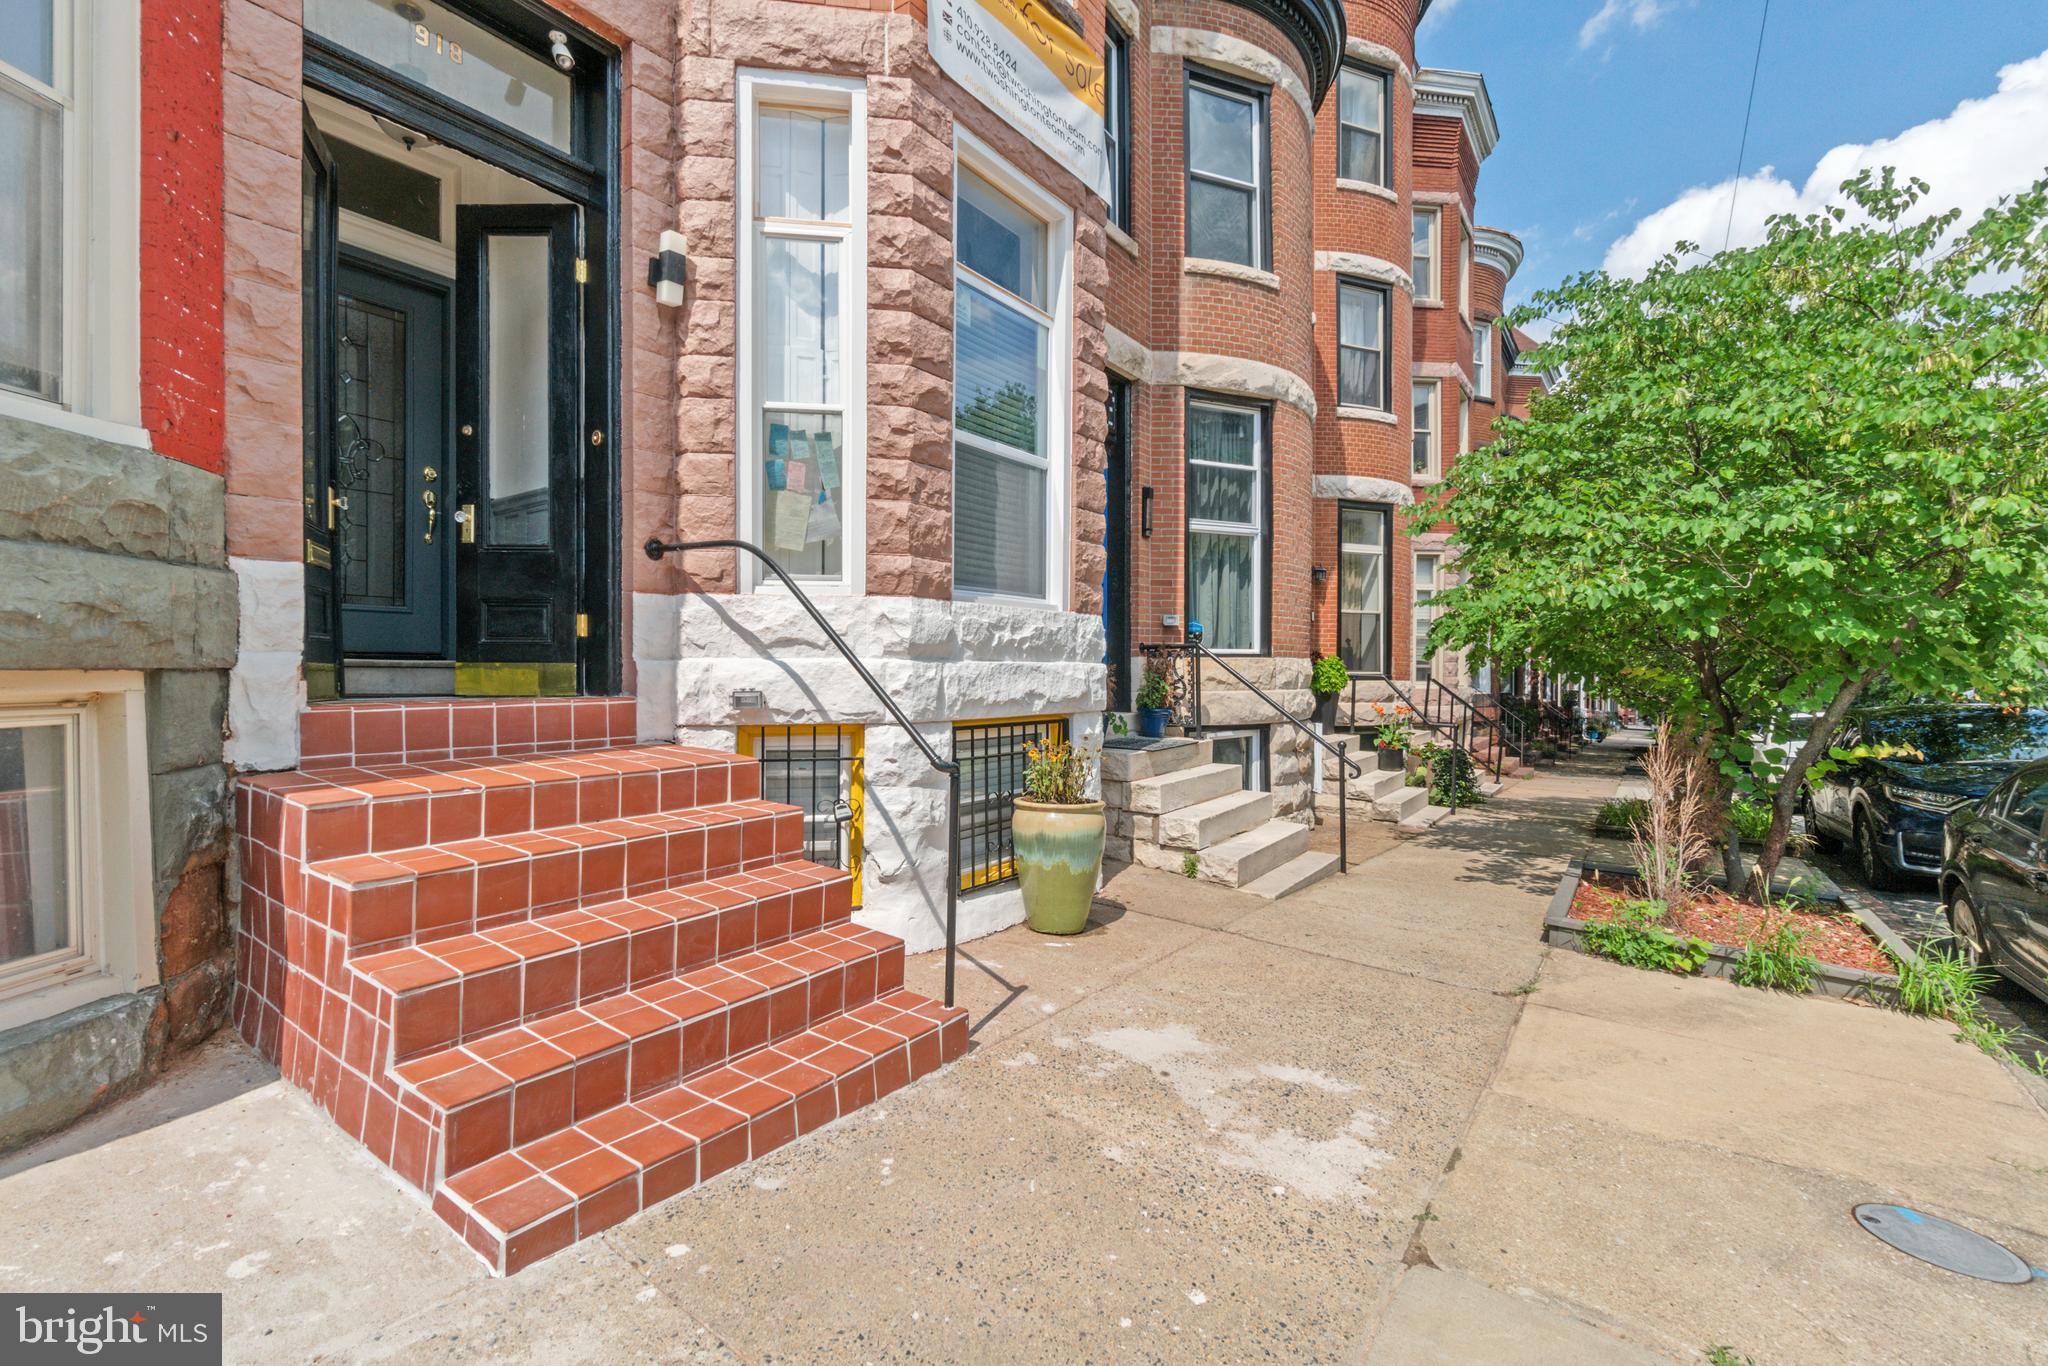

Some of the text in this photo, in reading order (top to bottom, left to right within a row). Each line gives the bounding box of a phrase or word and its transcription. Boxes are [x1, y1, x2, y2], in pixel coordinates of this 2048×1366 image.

[415, 23, 464, 65] 918
[956, 6, 1018, 73] 410.928.8424
[956, 40, 1086, 157] www.twashingtonteam.com
[1065, 51, 1105, 106] sale
